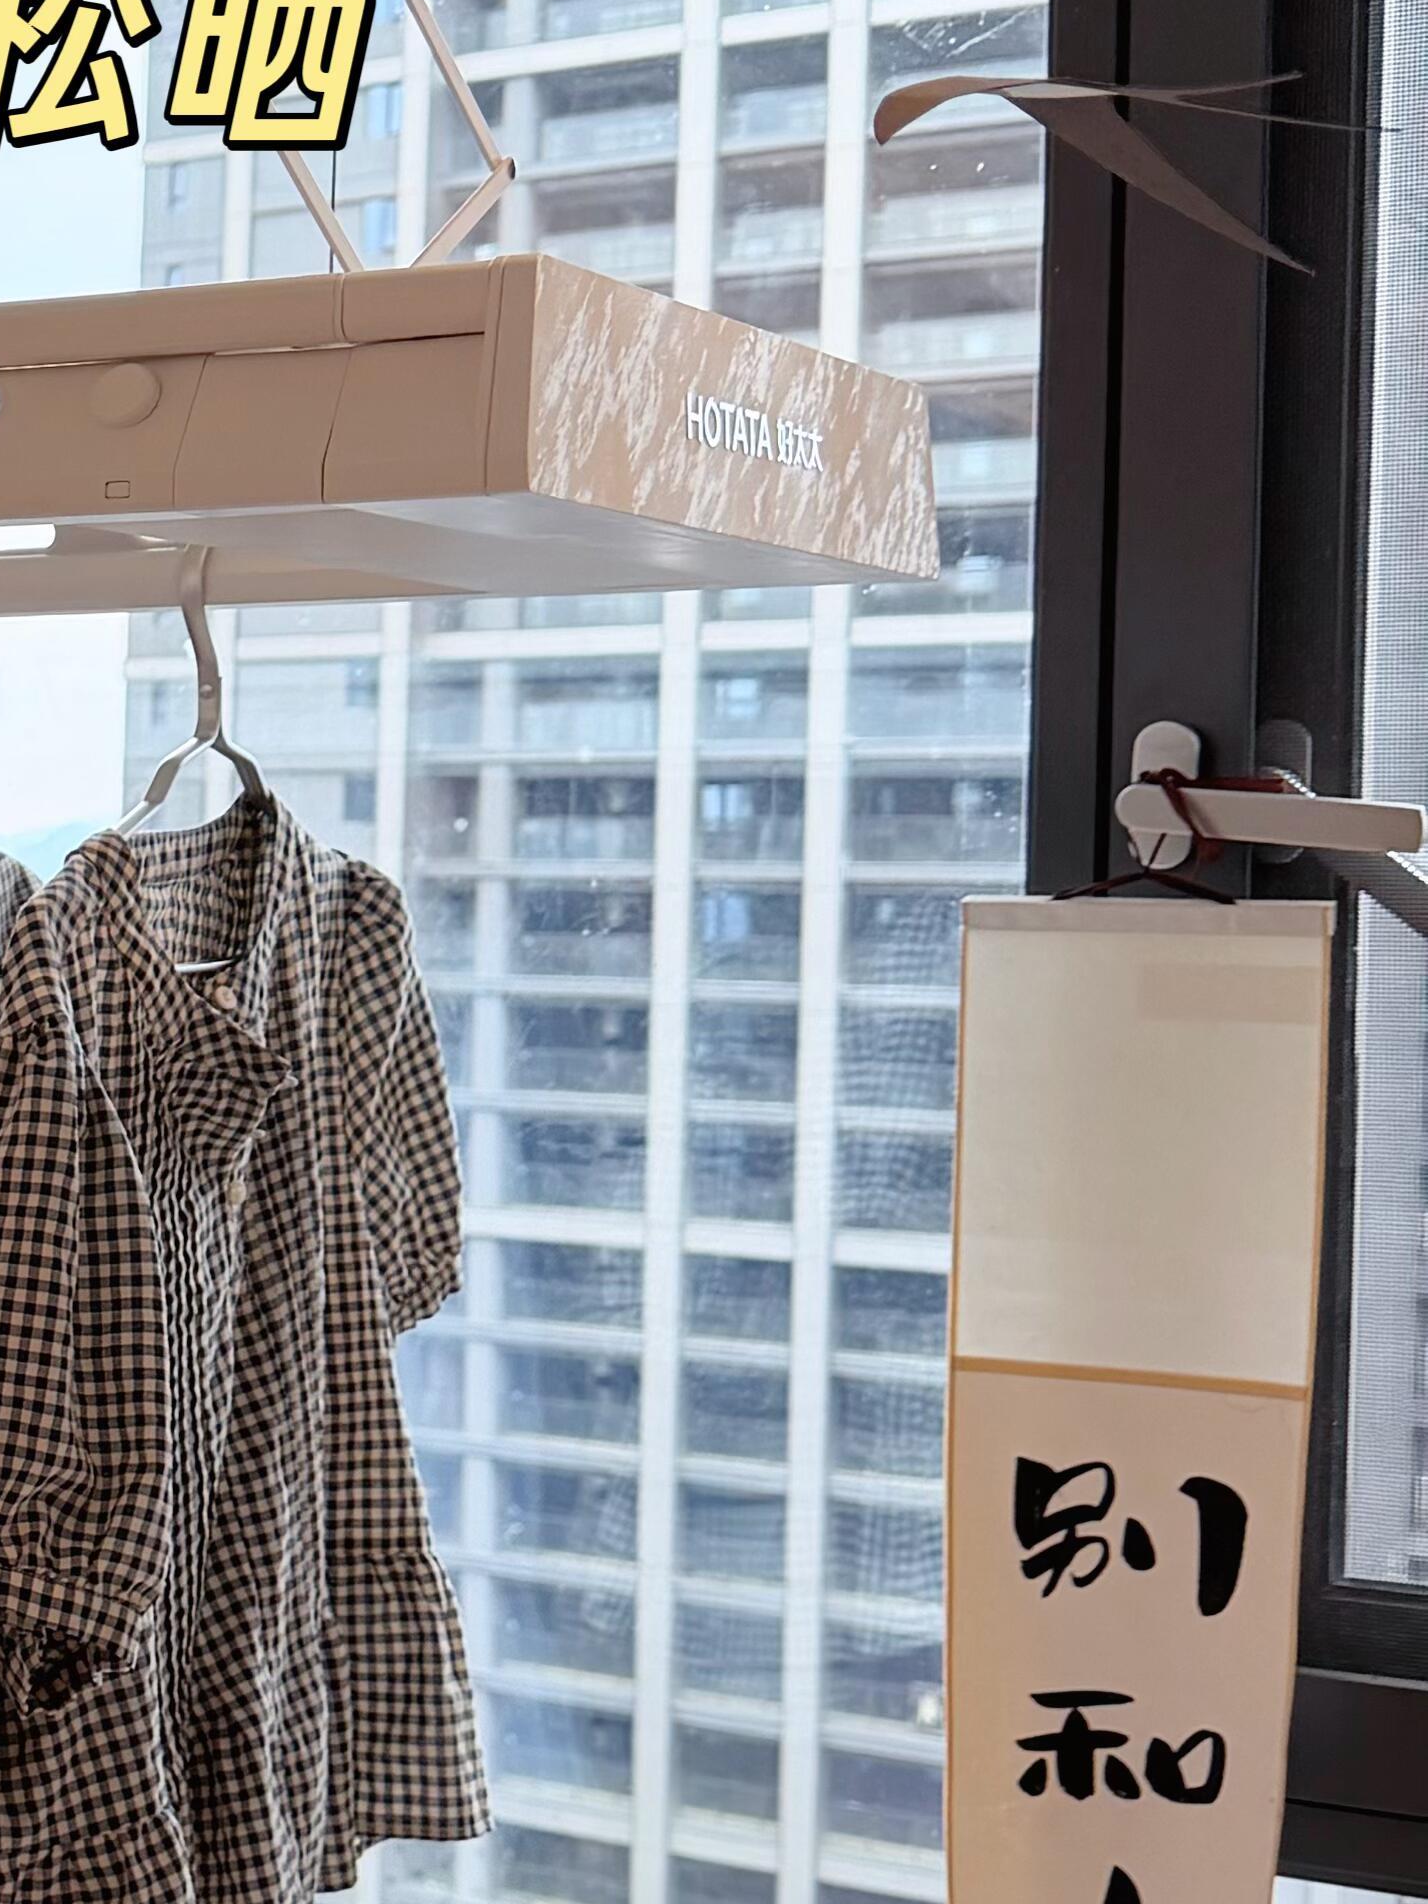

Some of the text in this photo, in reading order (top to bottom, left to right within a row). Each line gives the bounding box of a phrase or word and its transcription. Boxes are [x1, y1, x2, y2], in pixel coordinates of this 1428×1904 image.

[686, 392, 824, 472] HOTATA 好太太
